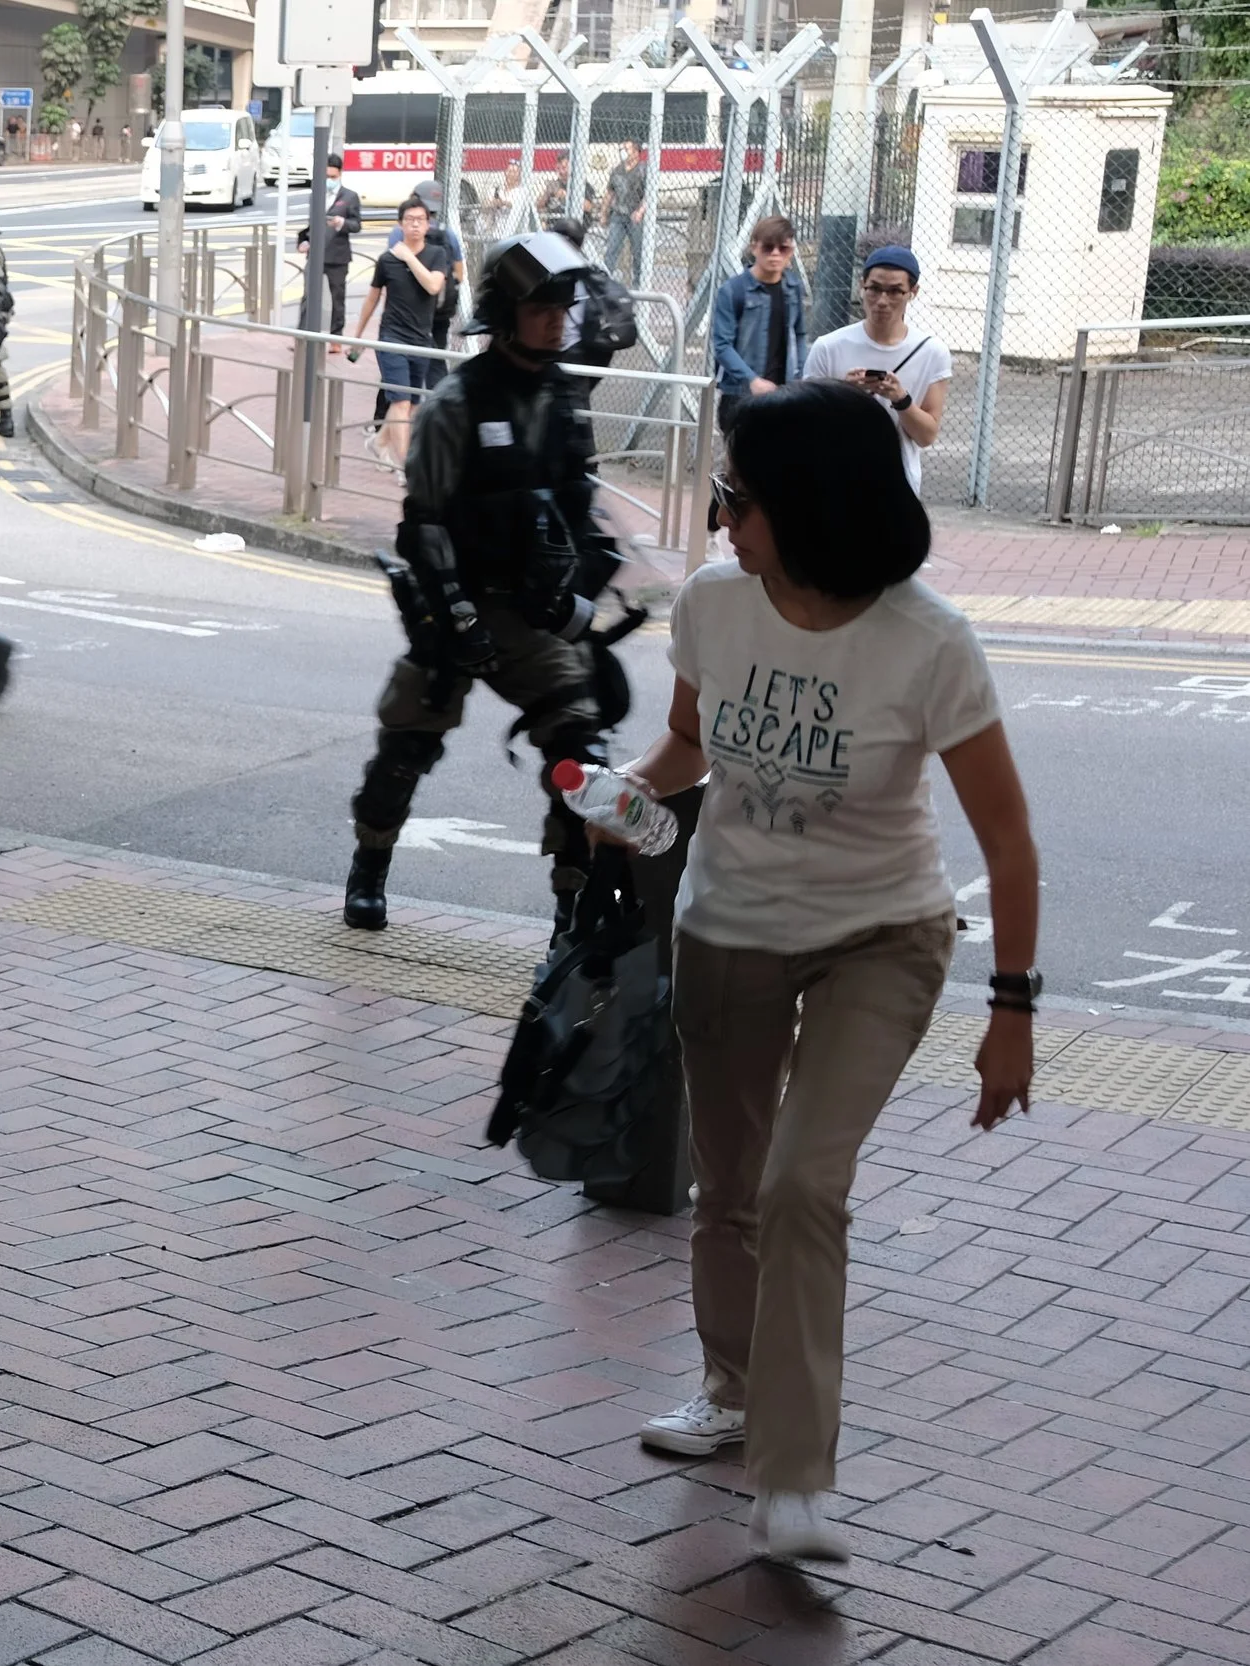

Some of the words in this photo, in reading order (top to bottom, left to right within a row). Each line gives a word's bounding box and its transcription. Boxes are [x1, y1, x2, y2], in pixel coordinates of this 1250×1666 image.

[382, 151, 434, 169] POLIC
[743, 664, 839, 722] LET'S
[712, 700, 854, 770] ESCAPE
